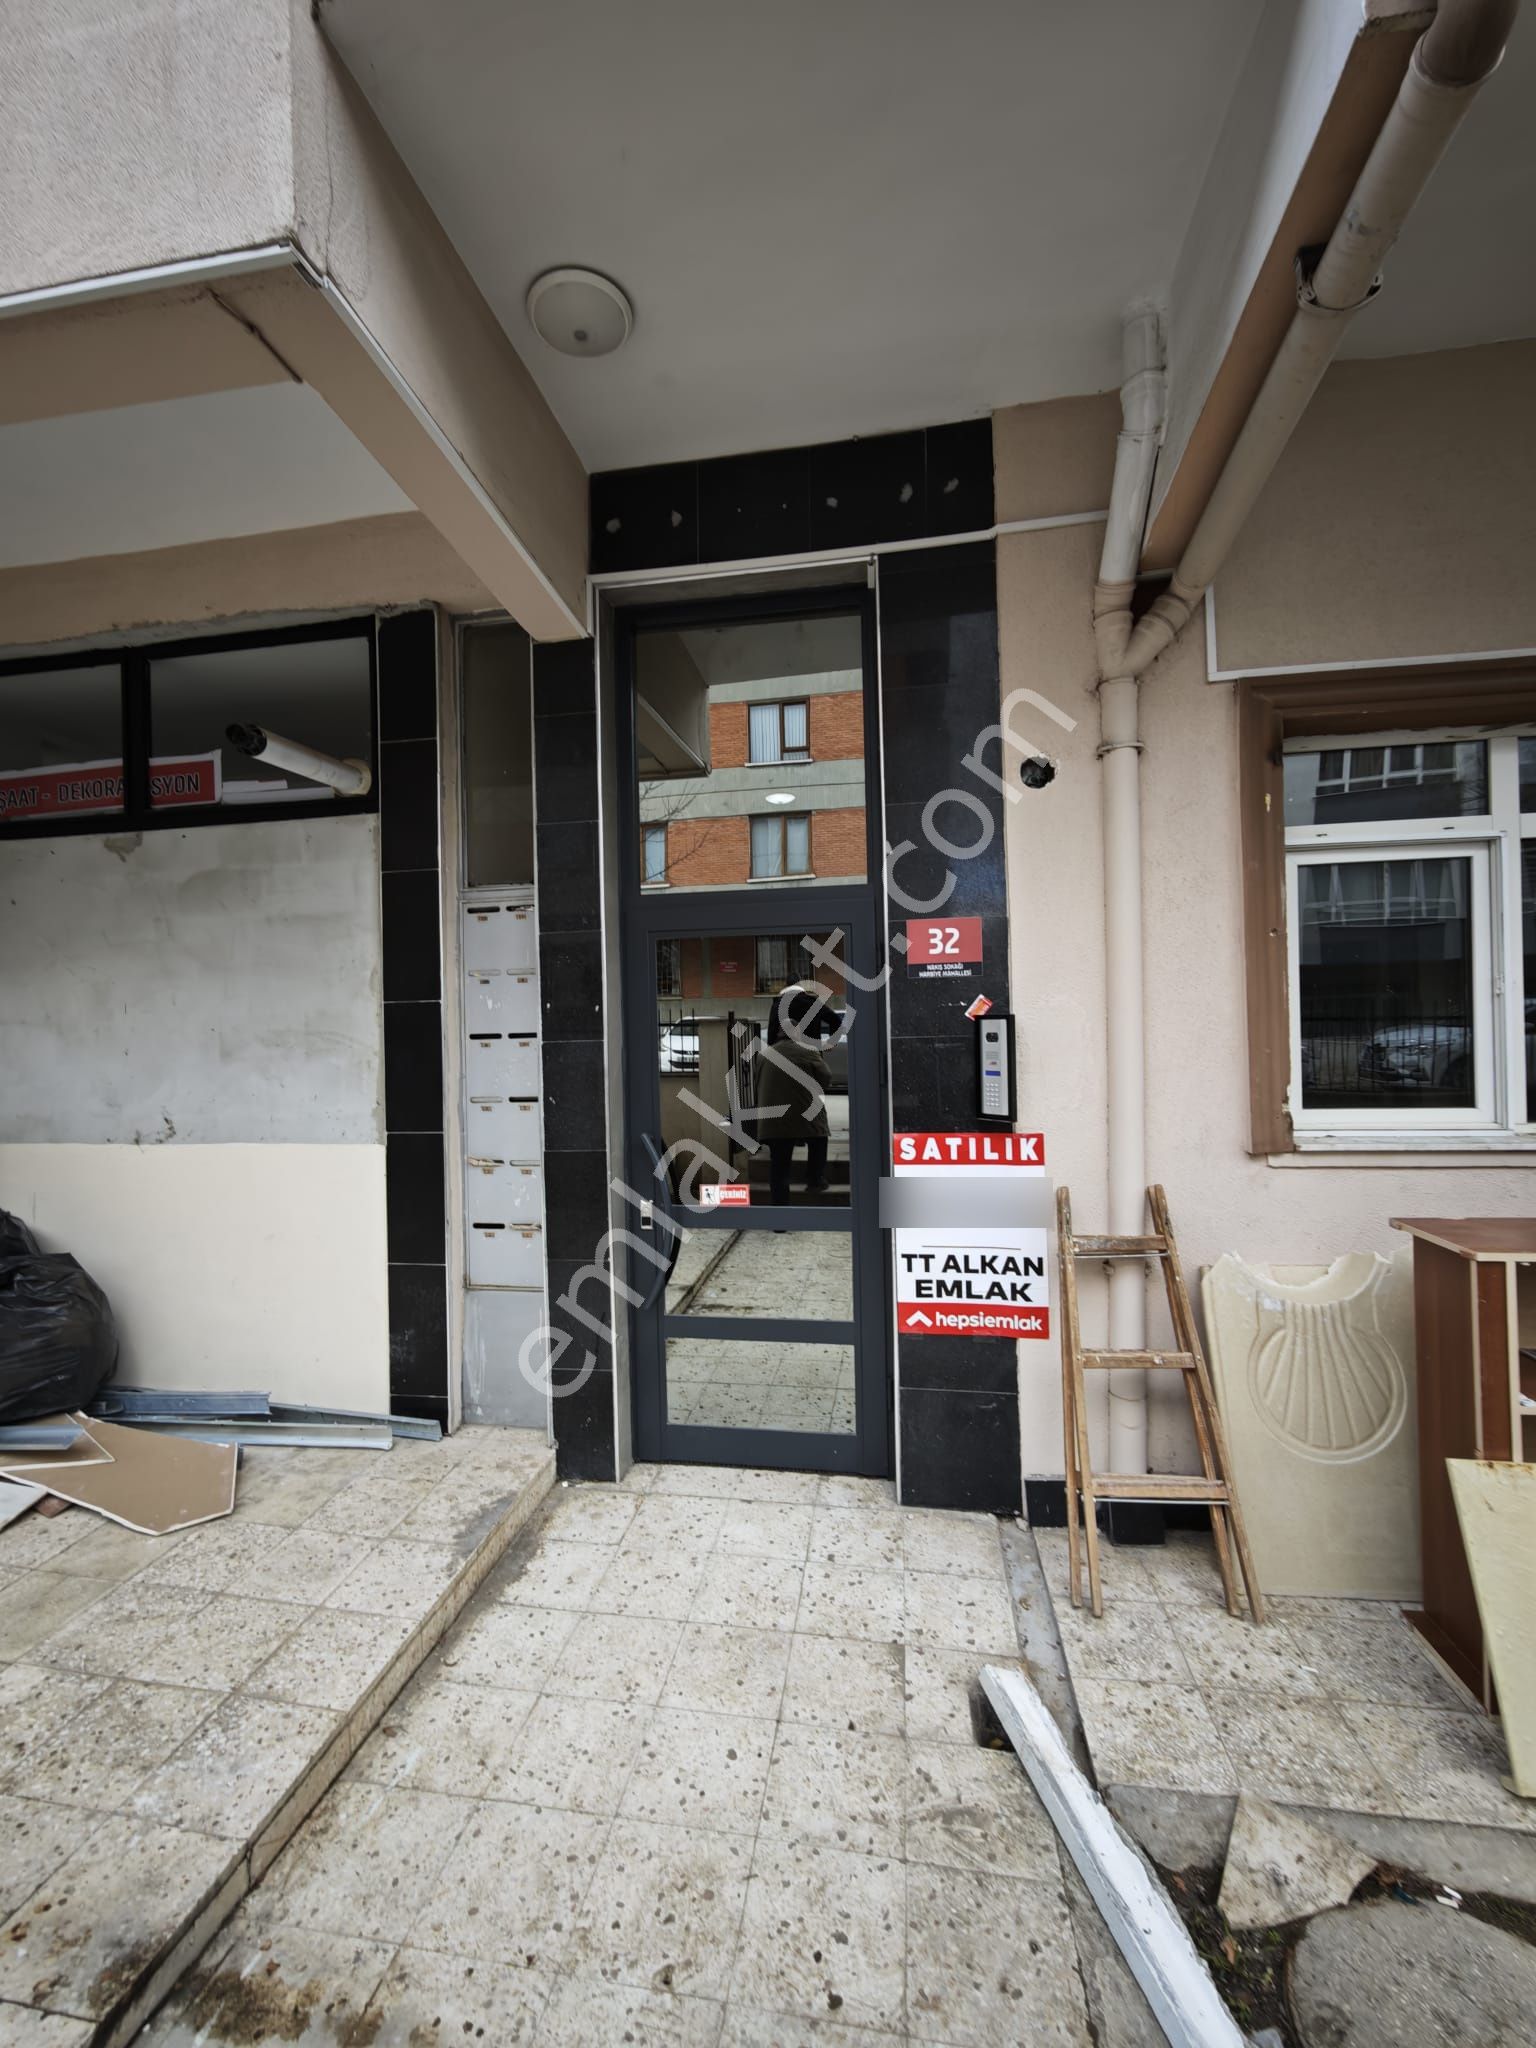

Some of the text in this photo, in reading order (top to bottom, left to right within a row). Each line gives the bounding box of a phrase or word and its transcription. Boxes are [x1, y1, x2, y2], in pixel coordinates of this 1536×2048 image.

[928, 927, 960, 955] 32
[900, 1137, 1039, 1161] SATILIK
[901, 1253, 1044, 1276] TT ALKAN
[915, 1279, 1033, 1302] EMLAK
[936, 1311, 1042, 1331] hepsiemlak
